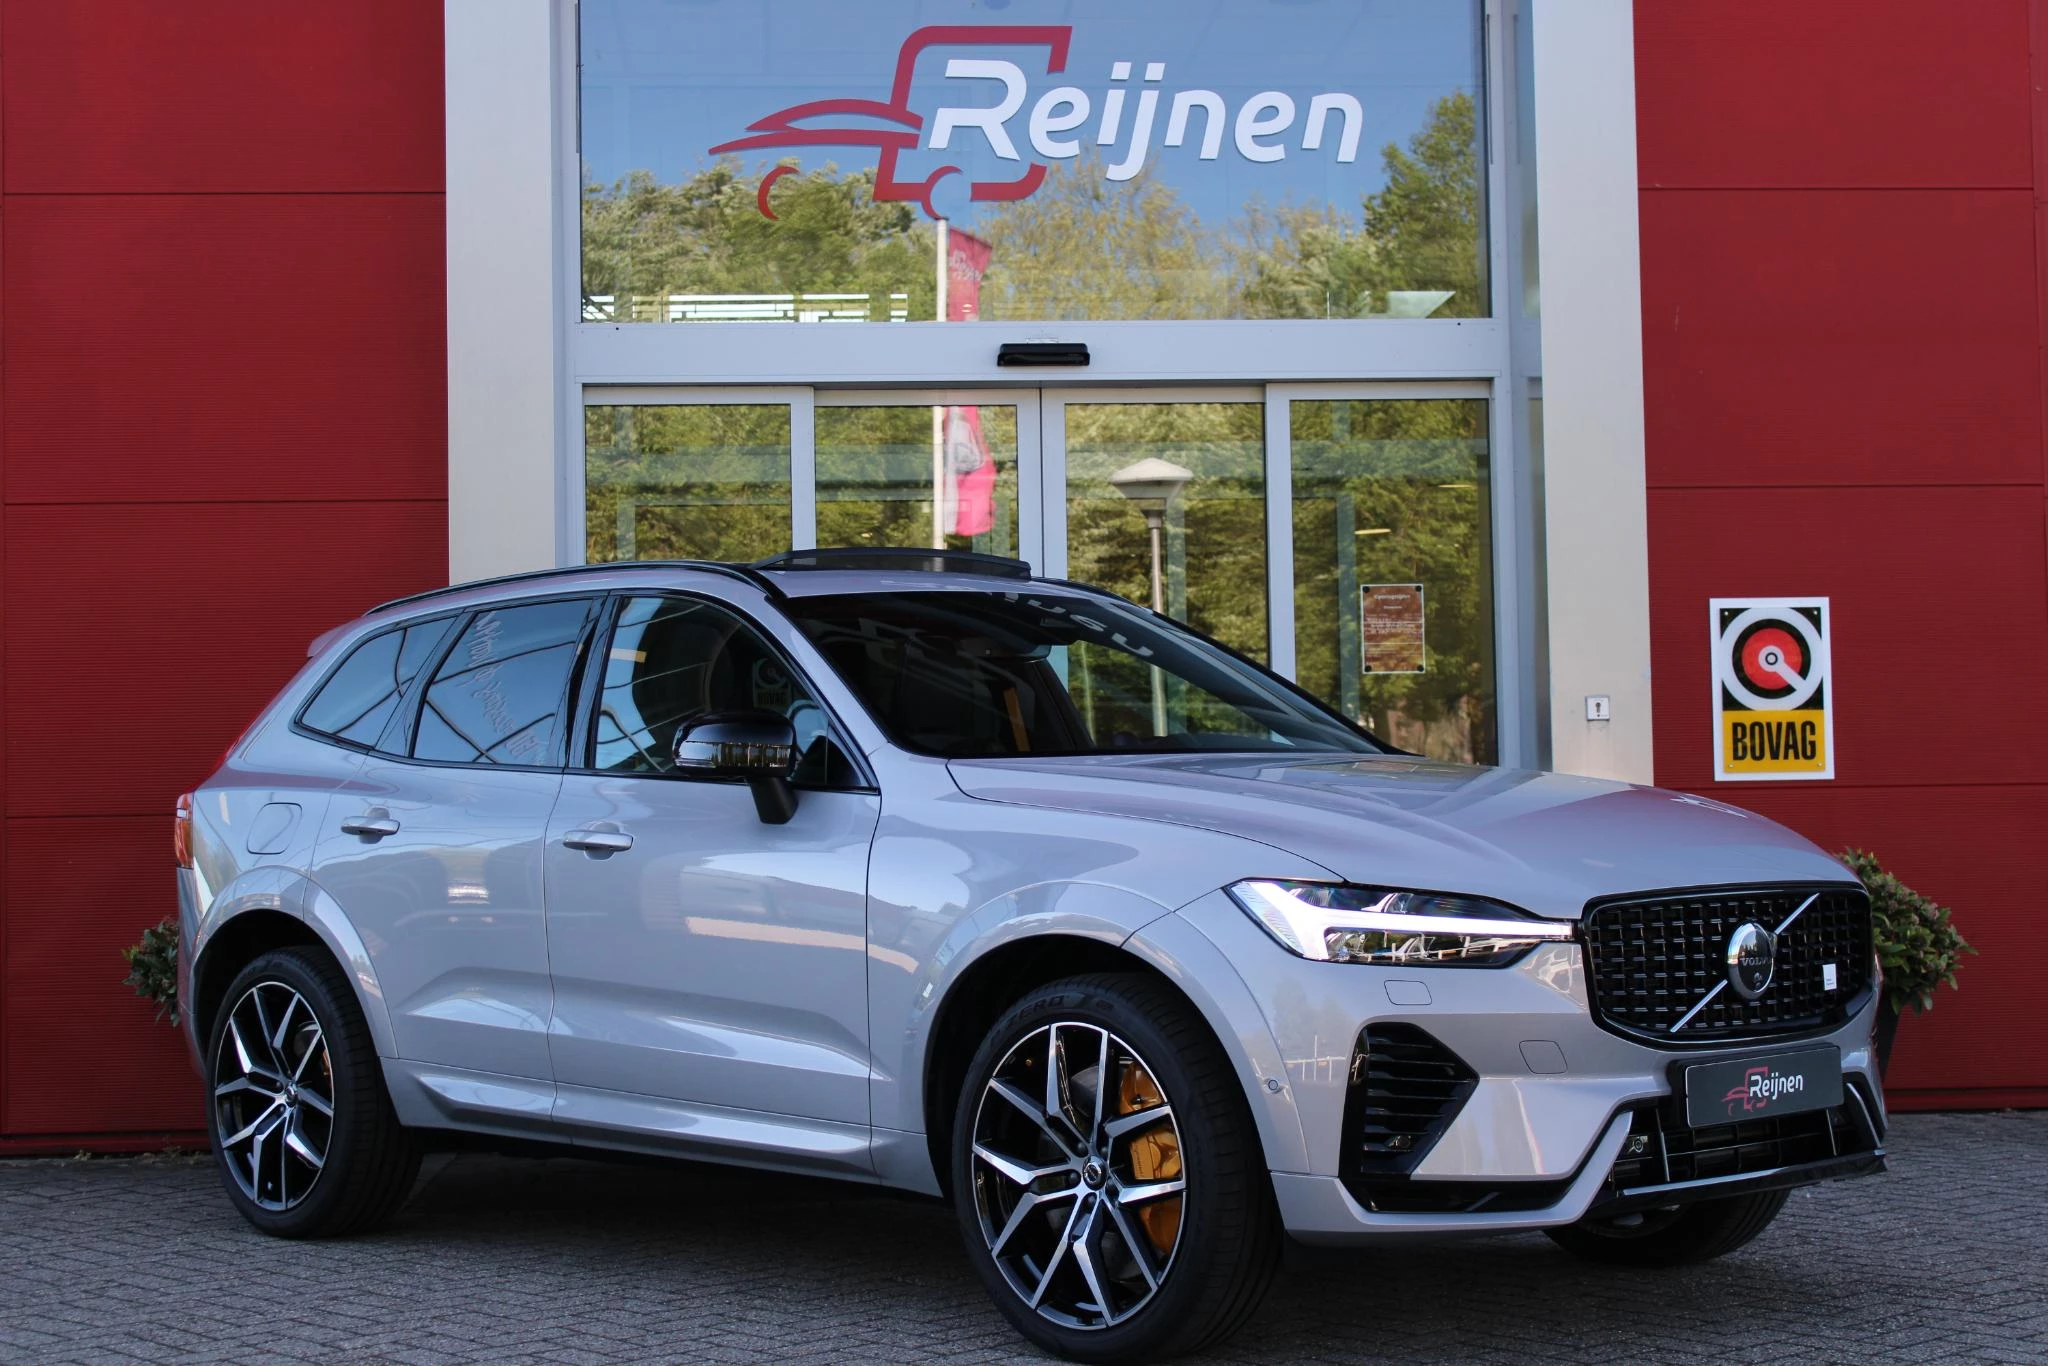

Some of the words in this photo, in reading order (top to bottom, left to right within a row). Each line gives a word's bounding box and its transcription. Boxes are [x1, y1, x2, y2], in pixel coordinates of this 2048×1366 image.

[928, 59, 1364, 182] Reijnen
[1732, 720, 1817, 761] BOVAG
[1750, 1072, 1804, 1100] Reijnen
